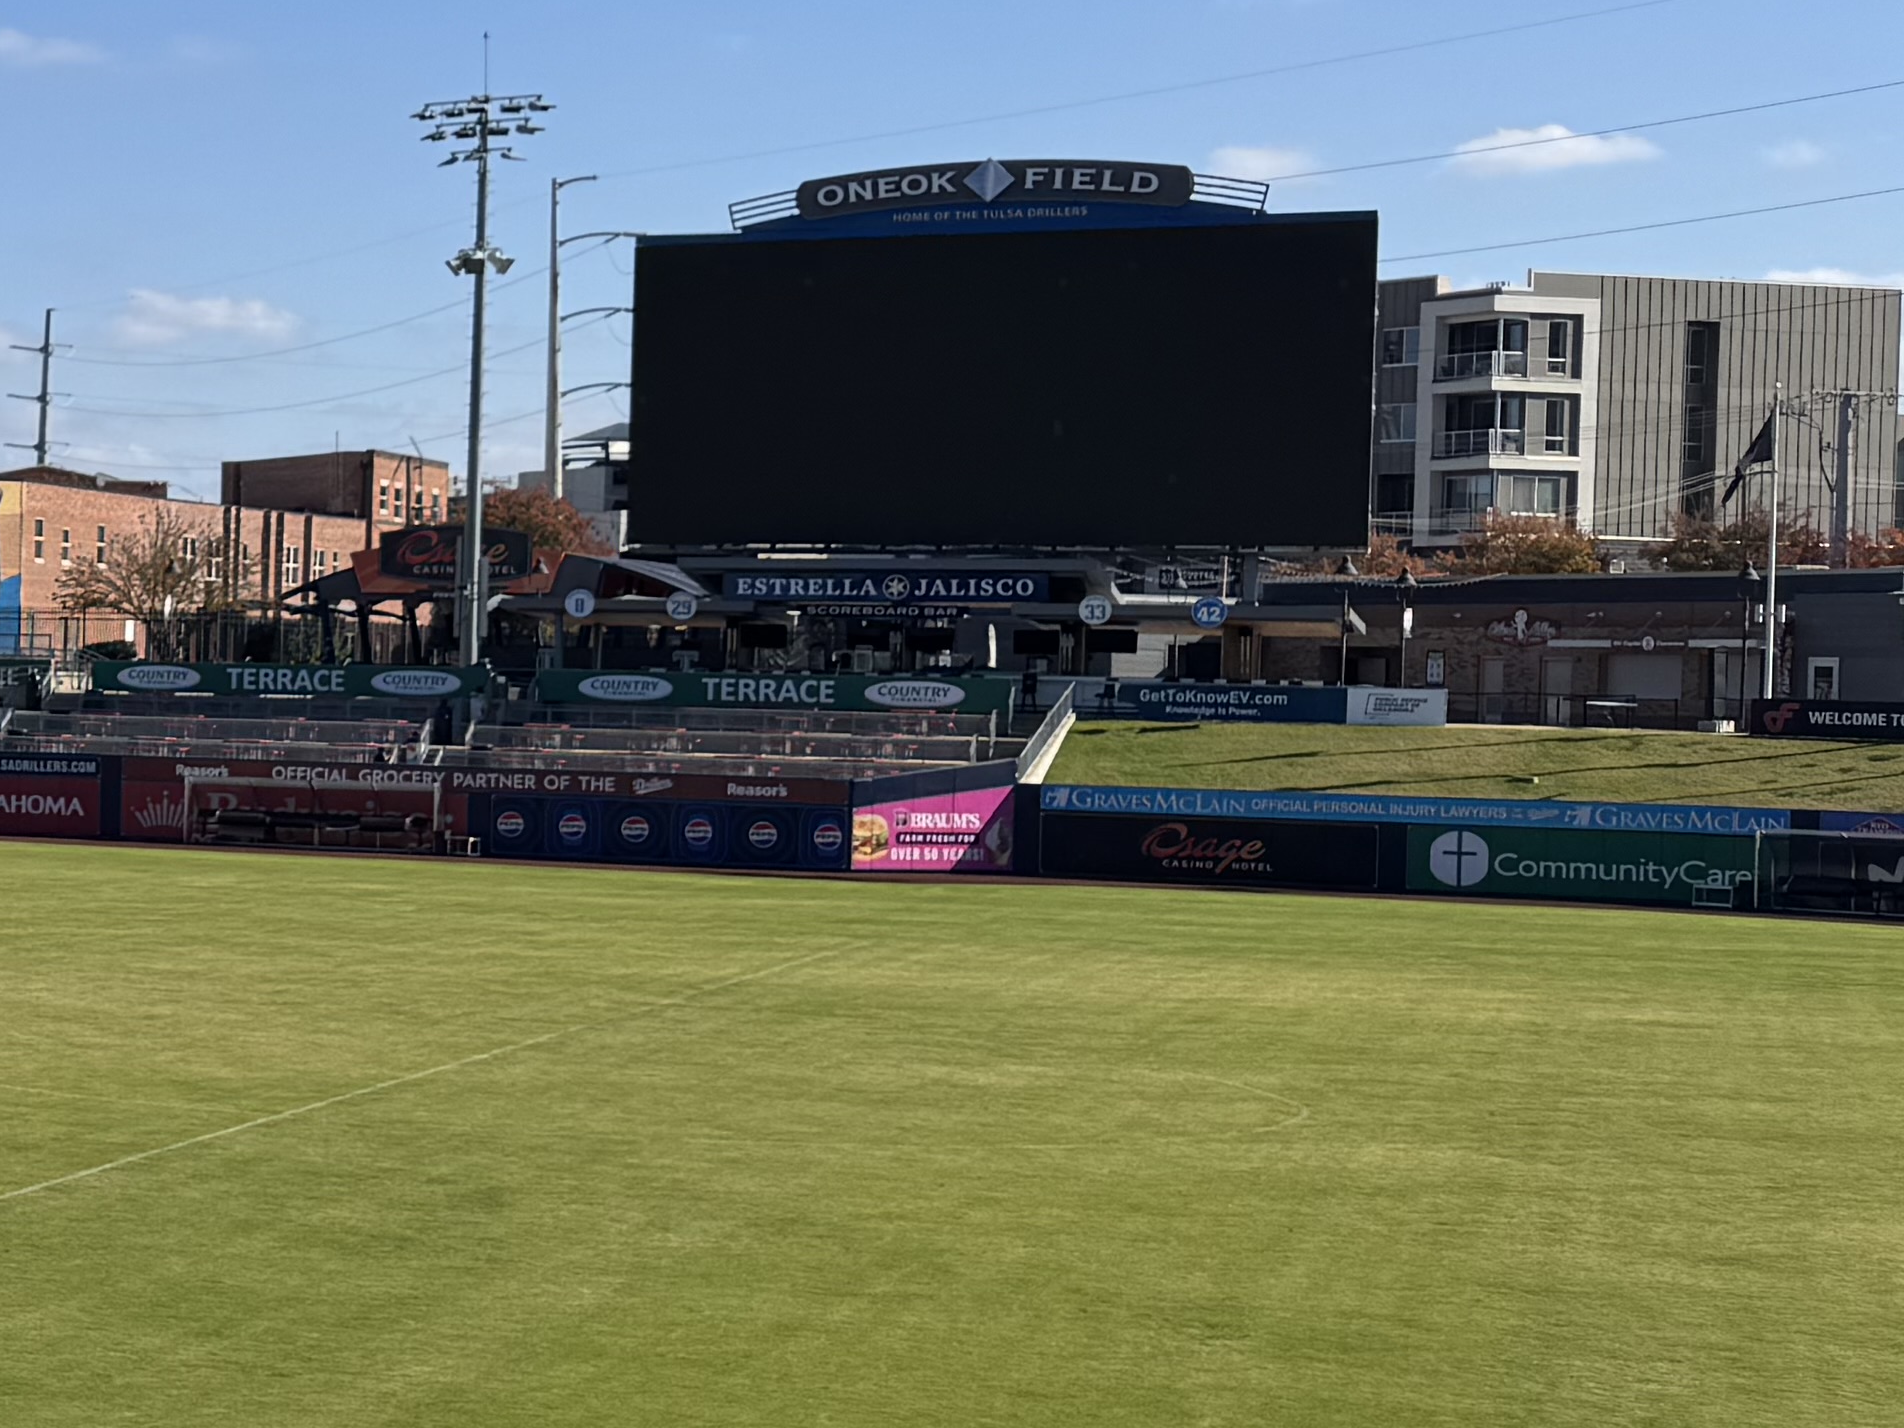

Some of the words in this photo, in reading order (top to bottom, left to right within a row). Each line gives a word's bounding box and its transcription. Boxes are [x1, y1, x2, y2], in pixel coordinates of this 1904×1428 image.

[816, 171, 957, 207] ONEOK
[1024, 167, 1160, 194] FIELD
[893, 211, 932, 223] HOME
[935, 210, 951, 222] OF
[955, 210, 978, 221] THE
[982, 208, 1024, 220] TULSA
[1027, 206, 1089, 219] DRILLERS
[736, 577, 878, 598] ESTRELLA
[913, 576, 1035, 597] JALISCO
[671, 598, 693, 616] 29
[807, 605, 920, 617] SCOREBOARD
[924, 606, 958, 617] BAR
[1084, 604, 1107, 621] 33
[1197, 606, 1221, 622] 42
[127, 667, 189, 681] COUNTRY
[226, 668, 345, 692] TERRACE
[382, 673, 448, 687] COUNTRY
[590, 679, 659, 692] COUNTRY
[701, 678, 836, 704] TERRACE
[878, 684, 951, 699] COUNTRY
[1139, 688, 1288, 706] GetToKnowEV.com
[1165, 705, 1215, 716] Knowledge
[1808, 711, 1888, 726] WELCOME
[271, 766, 350, 782] OFFICIAL
[358, 769, 446, 785] GROCERY
[452, 772, 537, 791] PARTNER
[543, 775, 570, 791] OF
[578, 775, 616, 792] THE
[726, 782, 789, 798] Reasor's
[1250, 798, 1311, 812] OFFICIAL
[1313, 800, 1387, 815] PERSONAL
[1389, 802, 1437, 818] INJURY
[1440, 805, 1508, 820] LAWYERS
[910, 813, 981, 829] BRAUM'S
[899, 834, 924, 843] FARM
[926, 834, 956, 843] FRESH
[890, 847, 920, 861] OVER
[924, 847, 940, 861] 50
[942, 848, 984, 861] YEARS!
[1142, 823, 1267, 874] Osage
[1162, 859, 1214, 870] CASINO
[1231, 862, 1273, 873] HOTEL
[1493, 852, 1753, 889] CommunityCare
